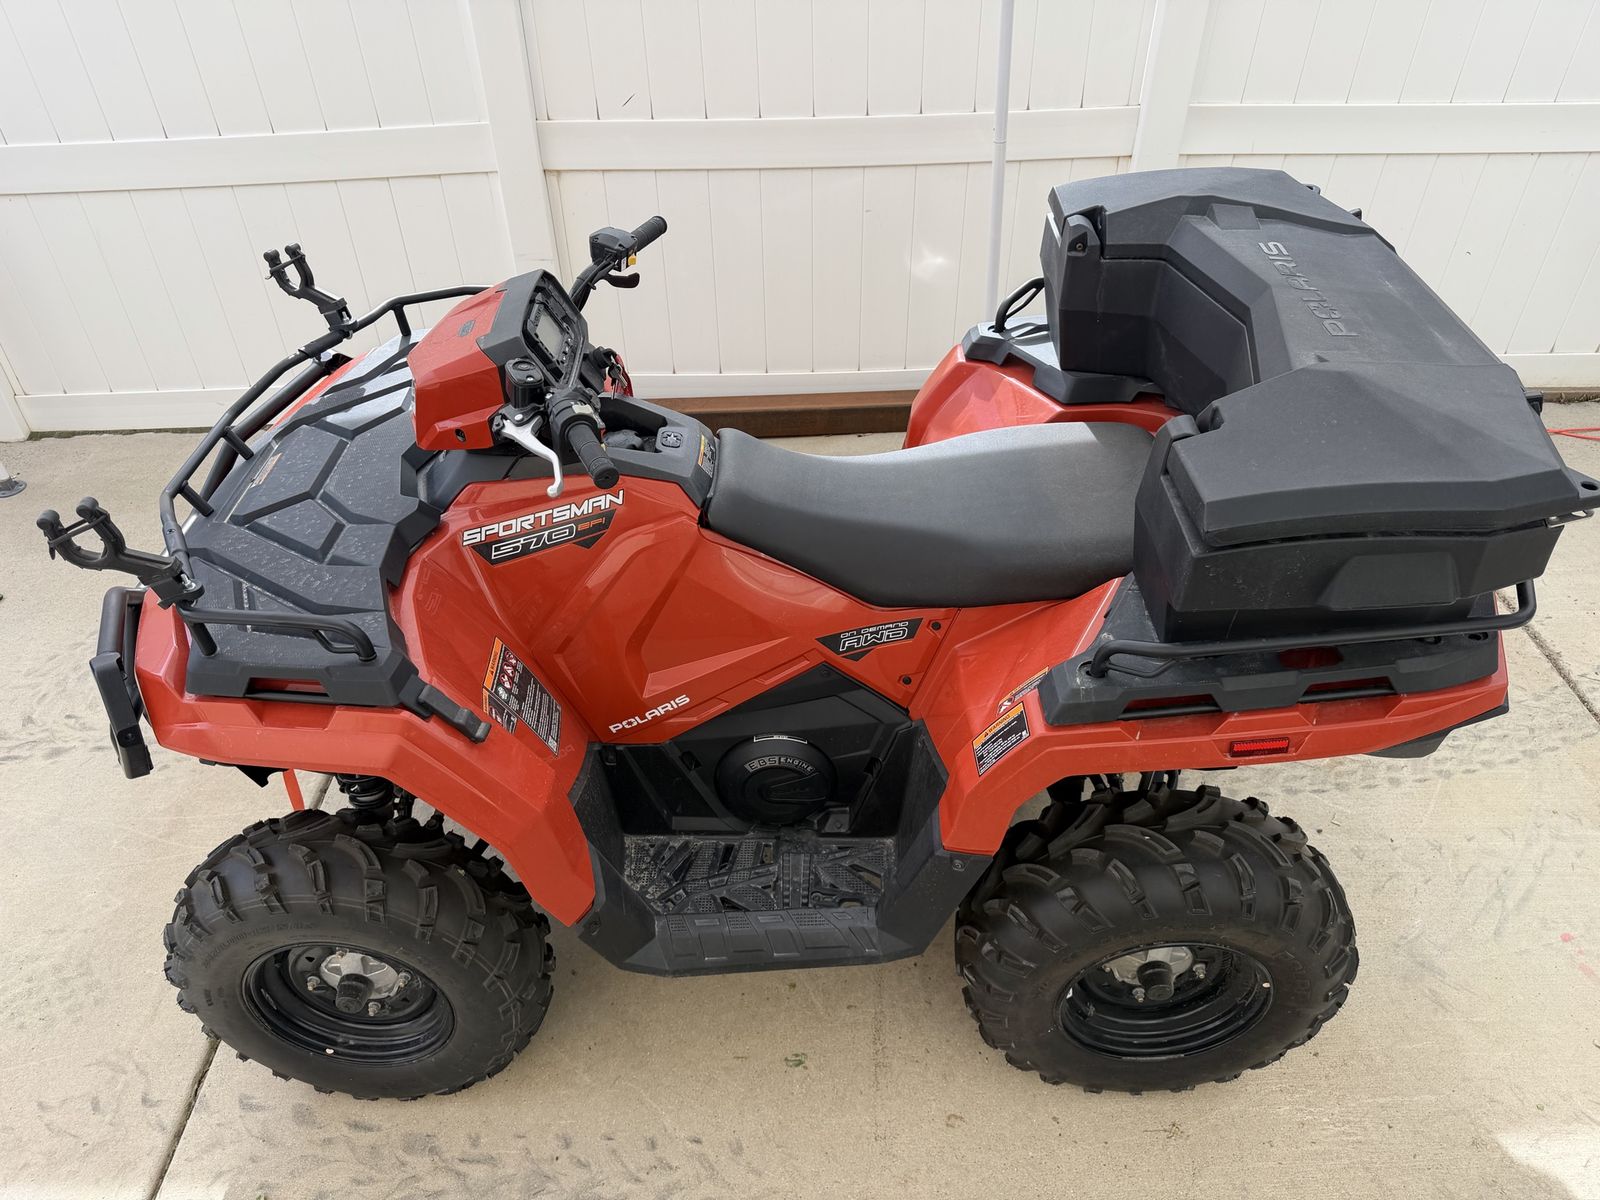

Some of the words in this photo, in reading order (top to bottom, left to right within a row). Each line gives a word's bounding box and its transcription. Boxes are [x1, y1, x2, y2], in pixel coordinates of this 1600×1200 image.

[1258, 241, 1360, 337] POLARIS
[462, 489, 625, 546] SPORTSMAN
[491, 523, 576, 560] 570
[839, 627, 908, 651] AWD
[861, 621, 909, 634] DEMAND
[608, 694, 691, 734] POLARIS
[748, 757, 777, 771] EBS
[780, 757, 814, 771] ENGINE
